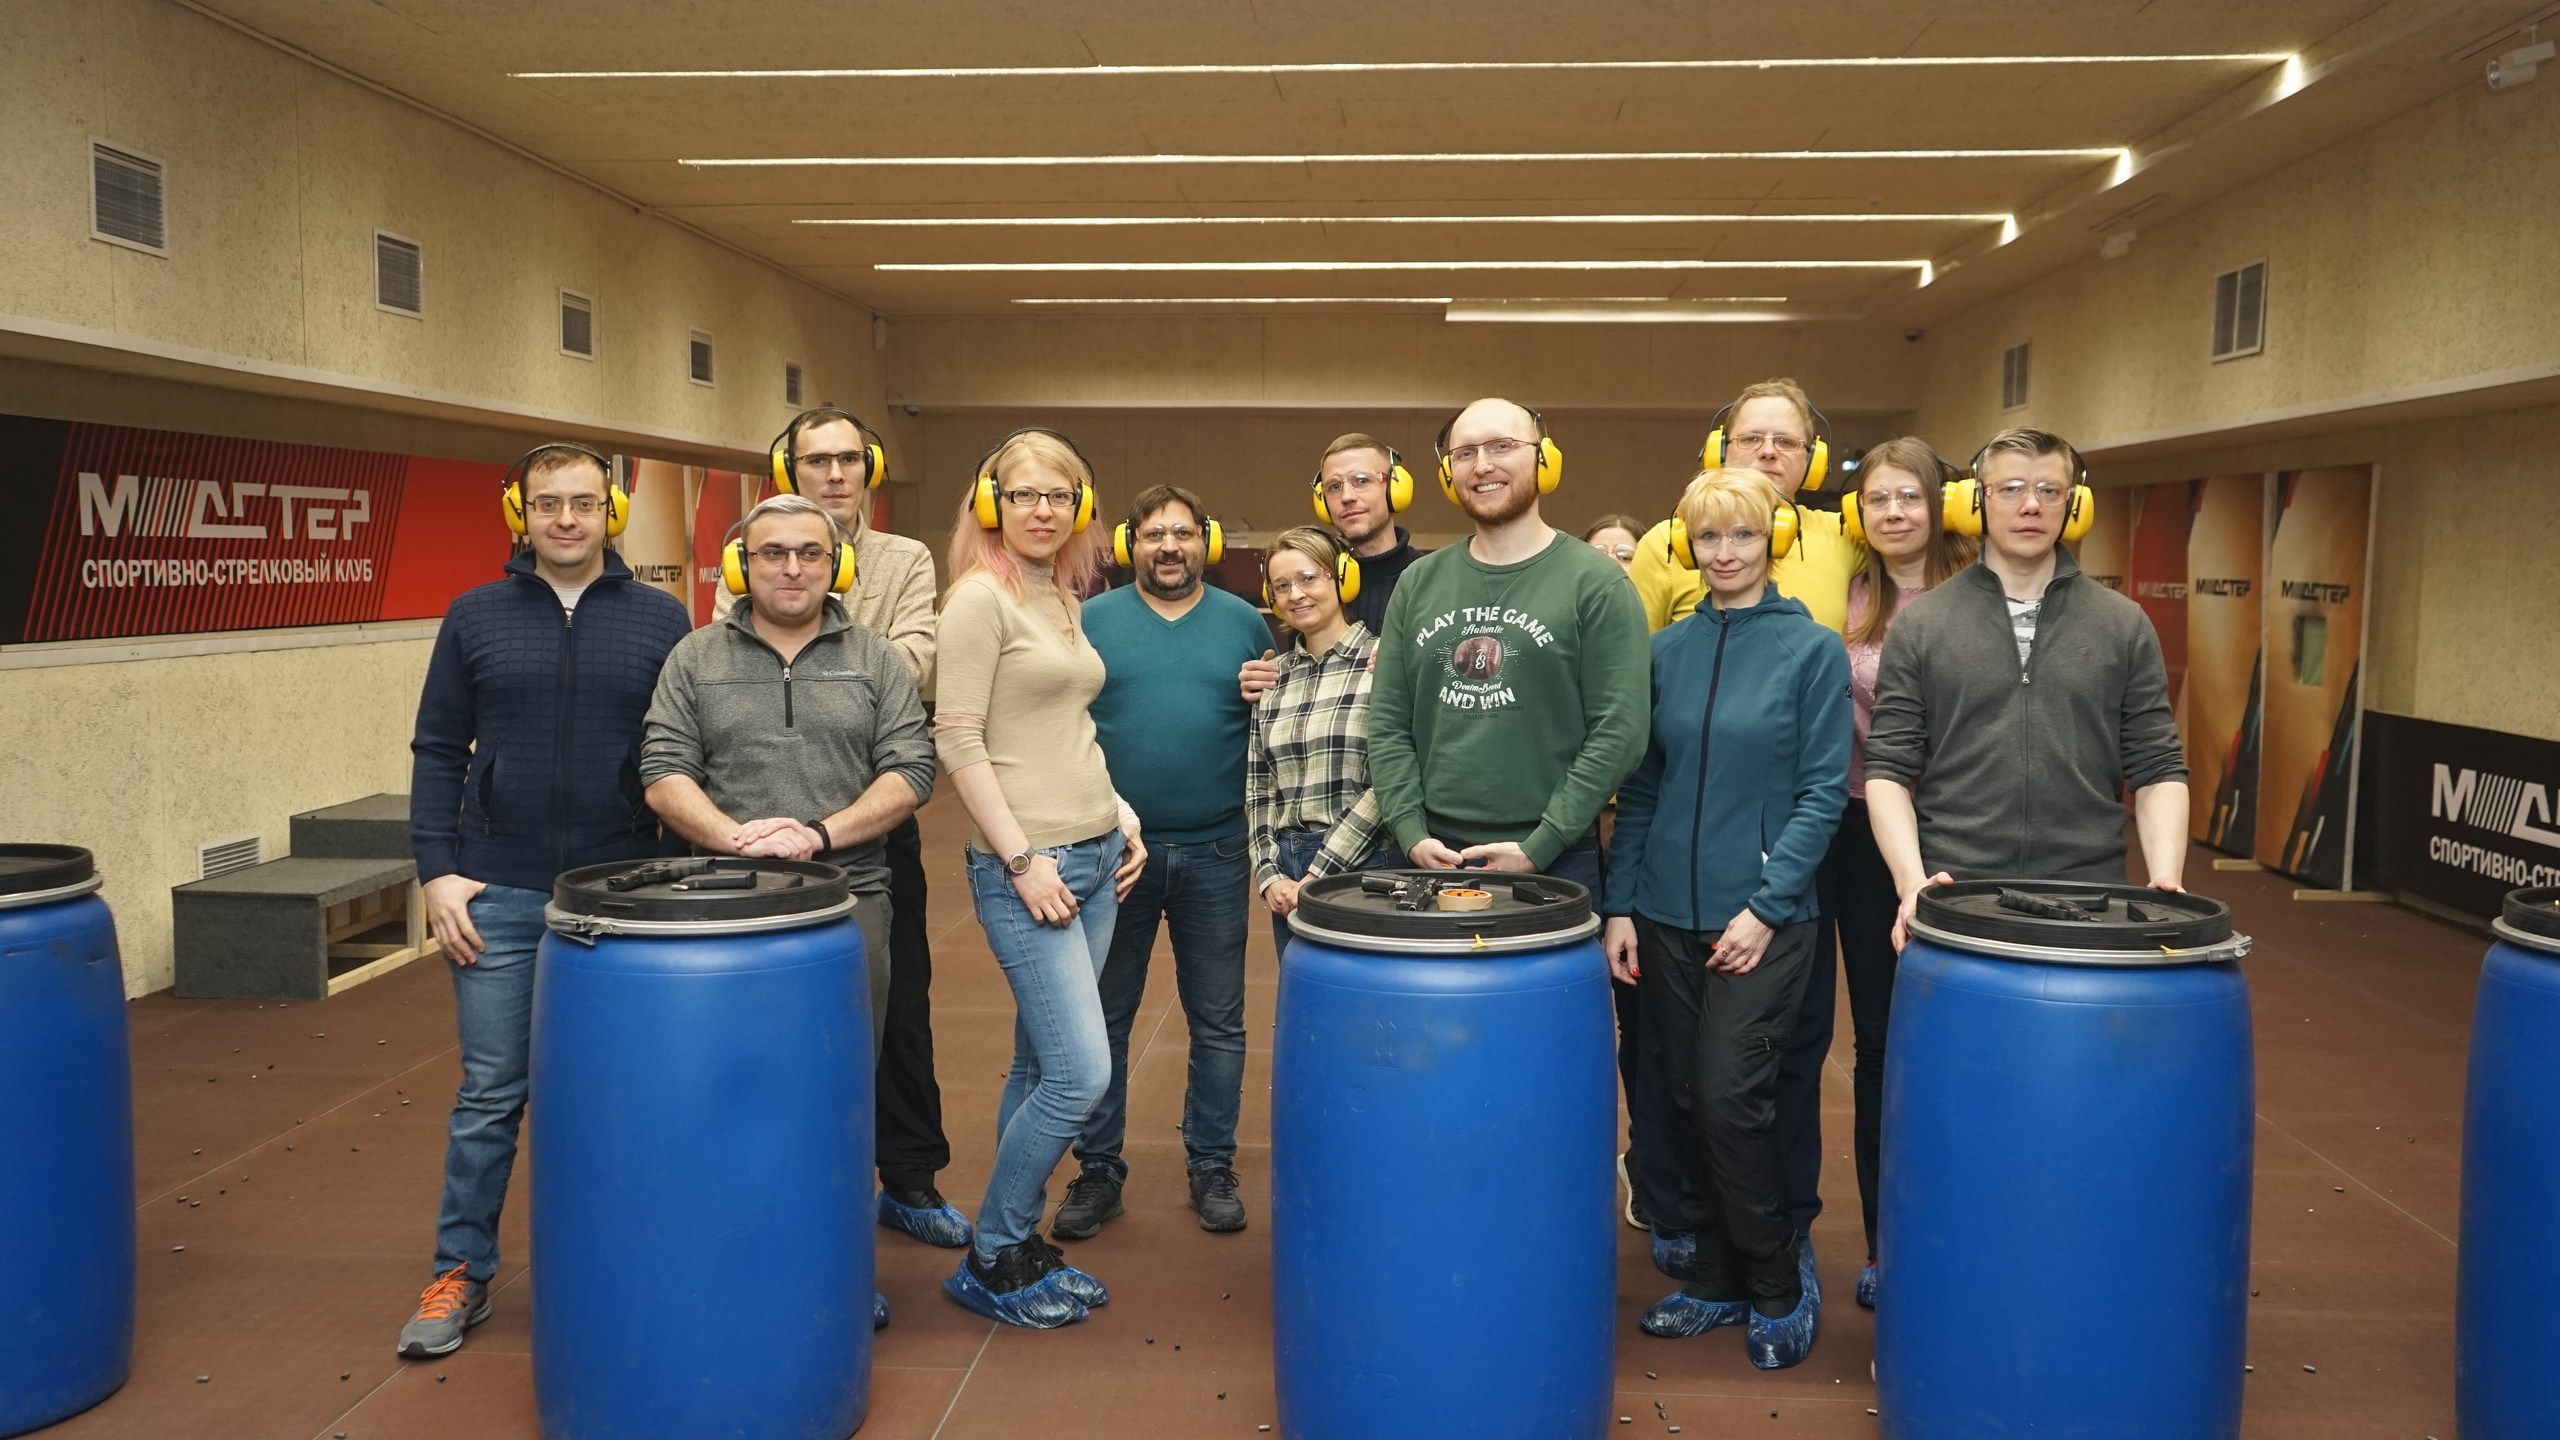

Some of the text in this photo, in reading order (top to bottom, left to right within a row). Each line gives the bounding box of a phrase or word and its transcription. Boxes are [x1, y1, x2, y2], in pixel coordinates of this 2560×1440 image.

[82, 552, 373, 588] СПОРТИВНО-СТРЕЛКОВЫЙ КЛУБ
[1416, 606, 1555, 648] PLAY THE GAME
[1439, 686, 1516, 710] AND WIN
